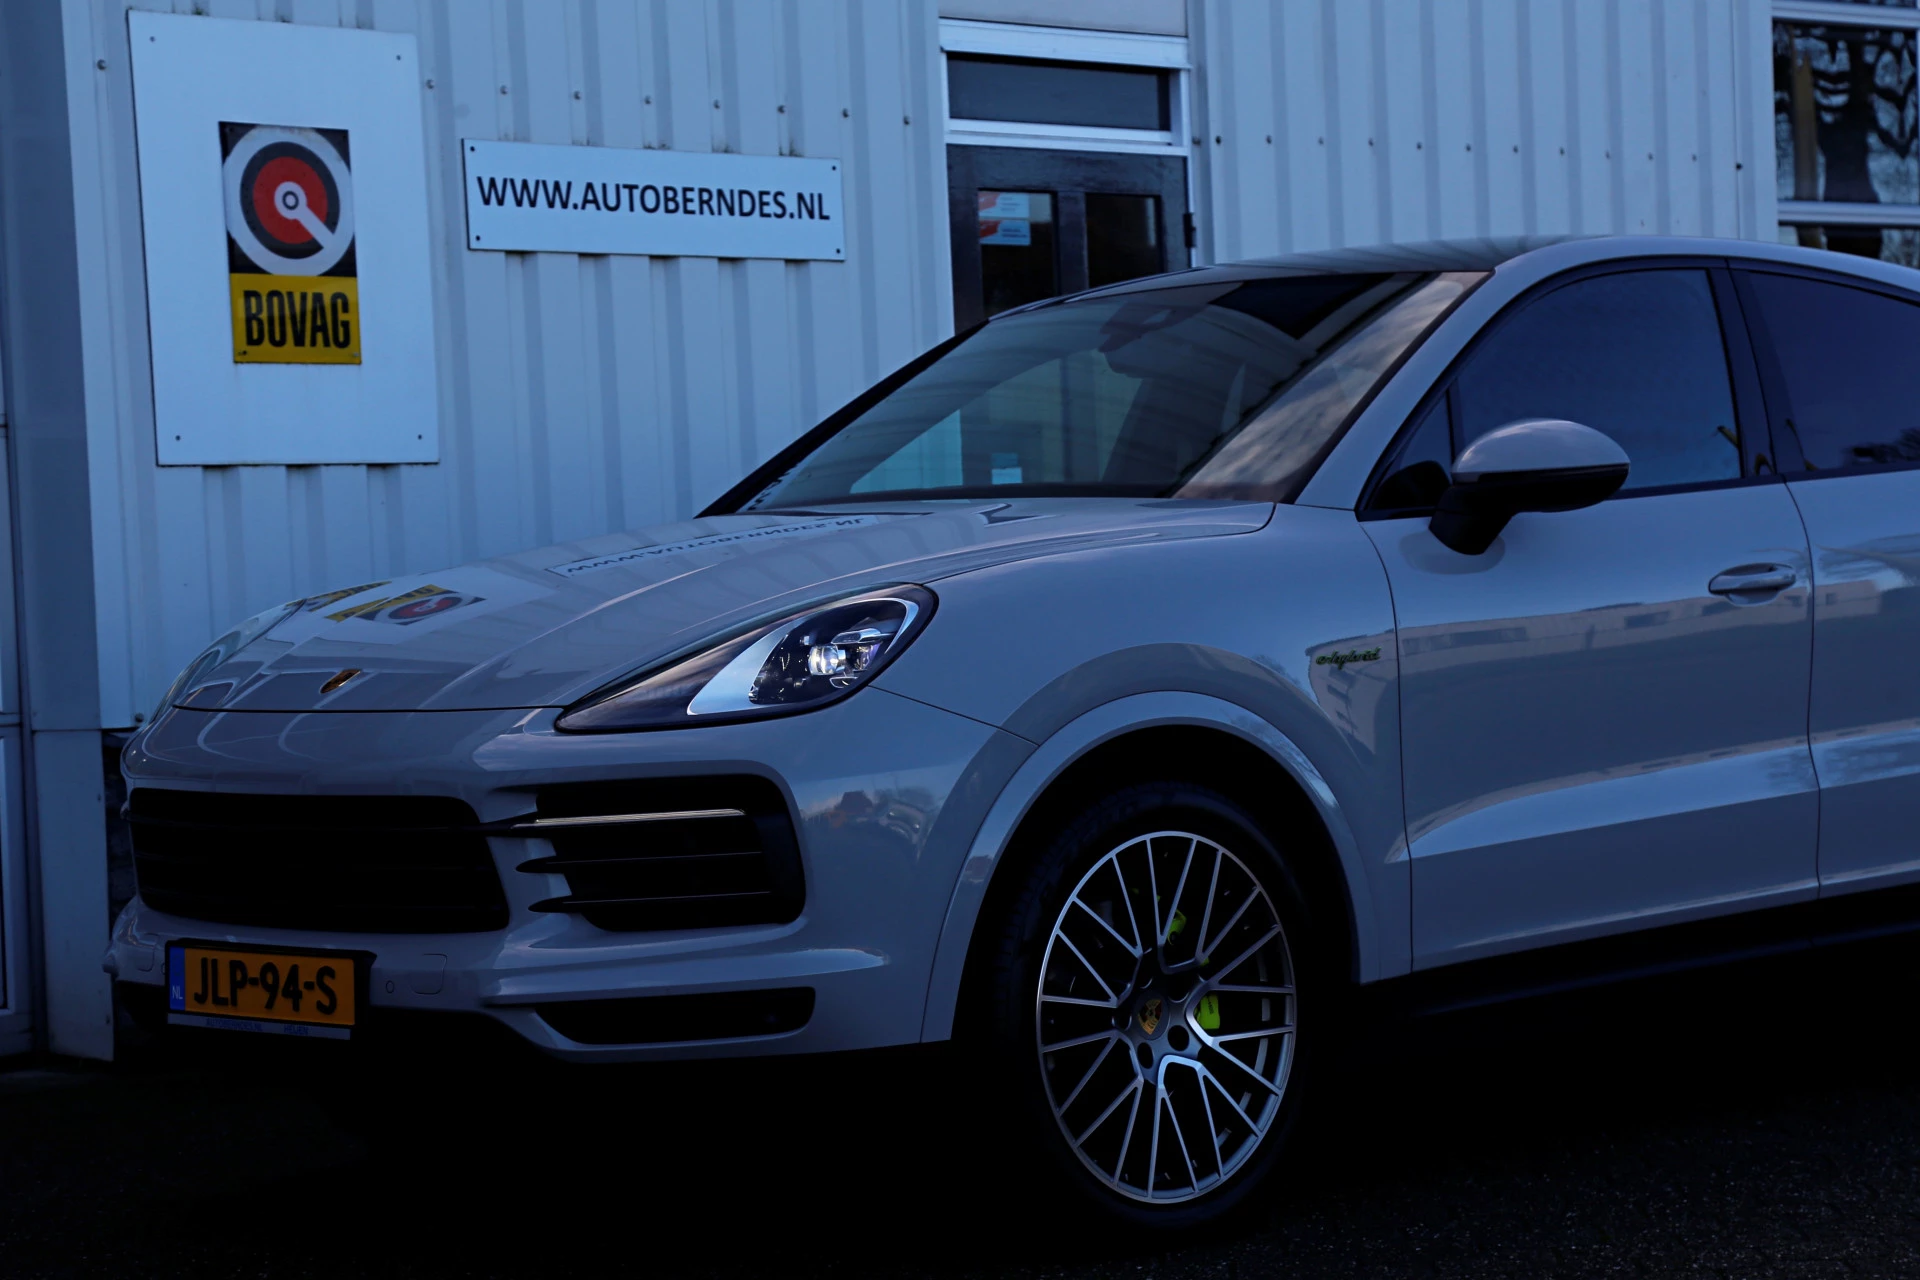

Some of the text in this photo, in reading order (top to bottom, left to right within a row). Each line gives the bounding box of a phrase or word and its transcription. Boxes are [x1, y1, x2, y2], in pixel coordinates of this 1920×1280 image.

[477, 177, 830, 220] WWW.AUTOBERNDES.NL
[244, 290, 350, 348] BOVAG
[172, 958, 337, 1014] NL JLP-94-S
